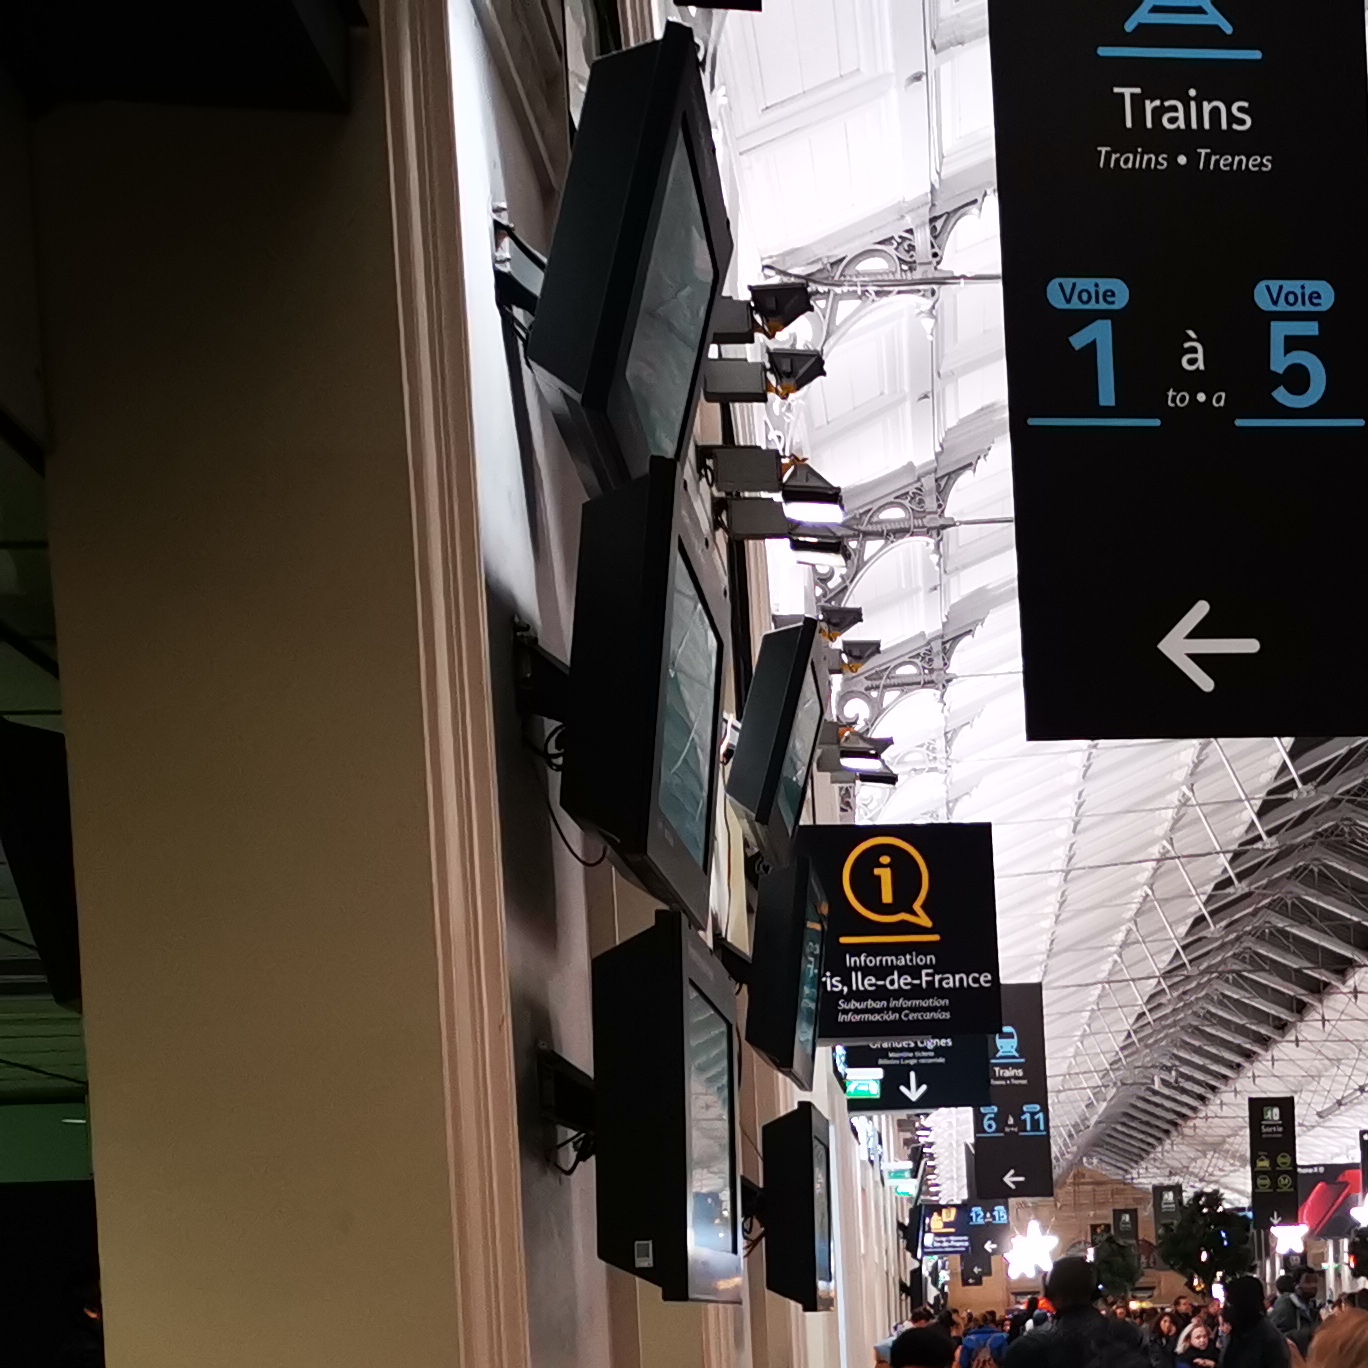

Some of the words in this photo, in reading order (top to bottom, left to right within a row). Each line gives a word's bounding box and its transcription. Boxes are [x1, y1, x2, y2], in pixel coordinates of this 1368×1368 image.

[1113, 86, 1252, 131] Trains
[1097, 146, 1168, 170] Trains
[1196, 148, 1273, 171] Trenes
[1058, 281, 1117, 305] Voie
[1264, 283, 1322, 307] Voie
[1067, 319, 1116, 407] 1
[1181, 330, 1205, 371] à
[1269, 320, 1327, 409] 5
[1166, 388, 1190, 408] to
[1211, 392, 1226, 408] a
[845, 951, 936, 967] Information
[821, 971, 848, 995] is,
[851, 968, 993, 992] Ile-de-France
[837, 998, 888, 1010] Suburban
[837, 1010, 900, 1022] Información
[901, 1009, 951, 1021] Cercanías
[992, 1066, 1023, 1077] Trains
[983, 1113, 997, 1133] 6
[1020, 1111, 1045, 1132] 11
